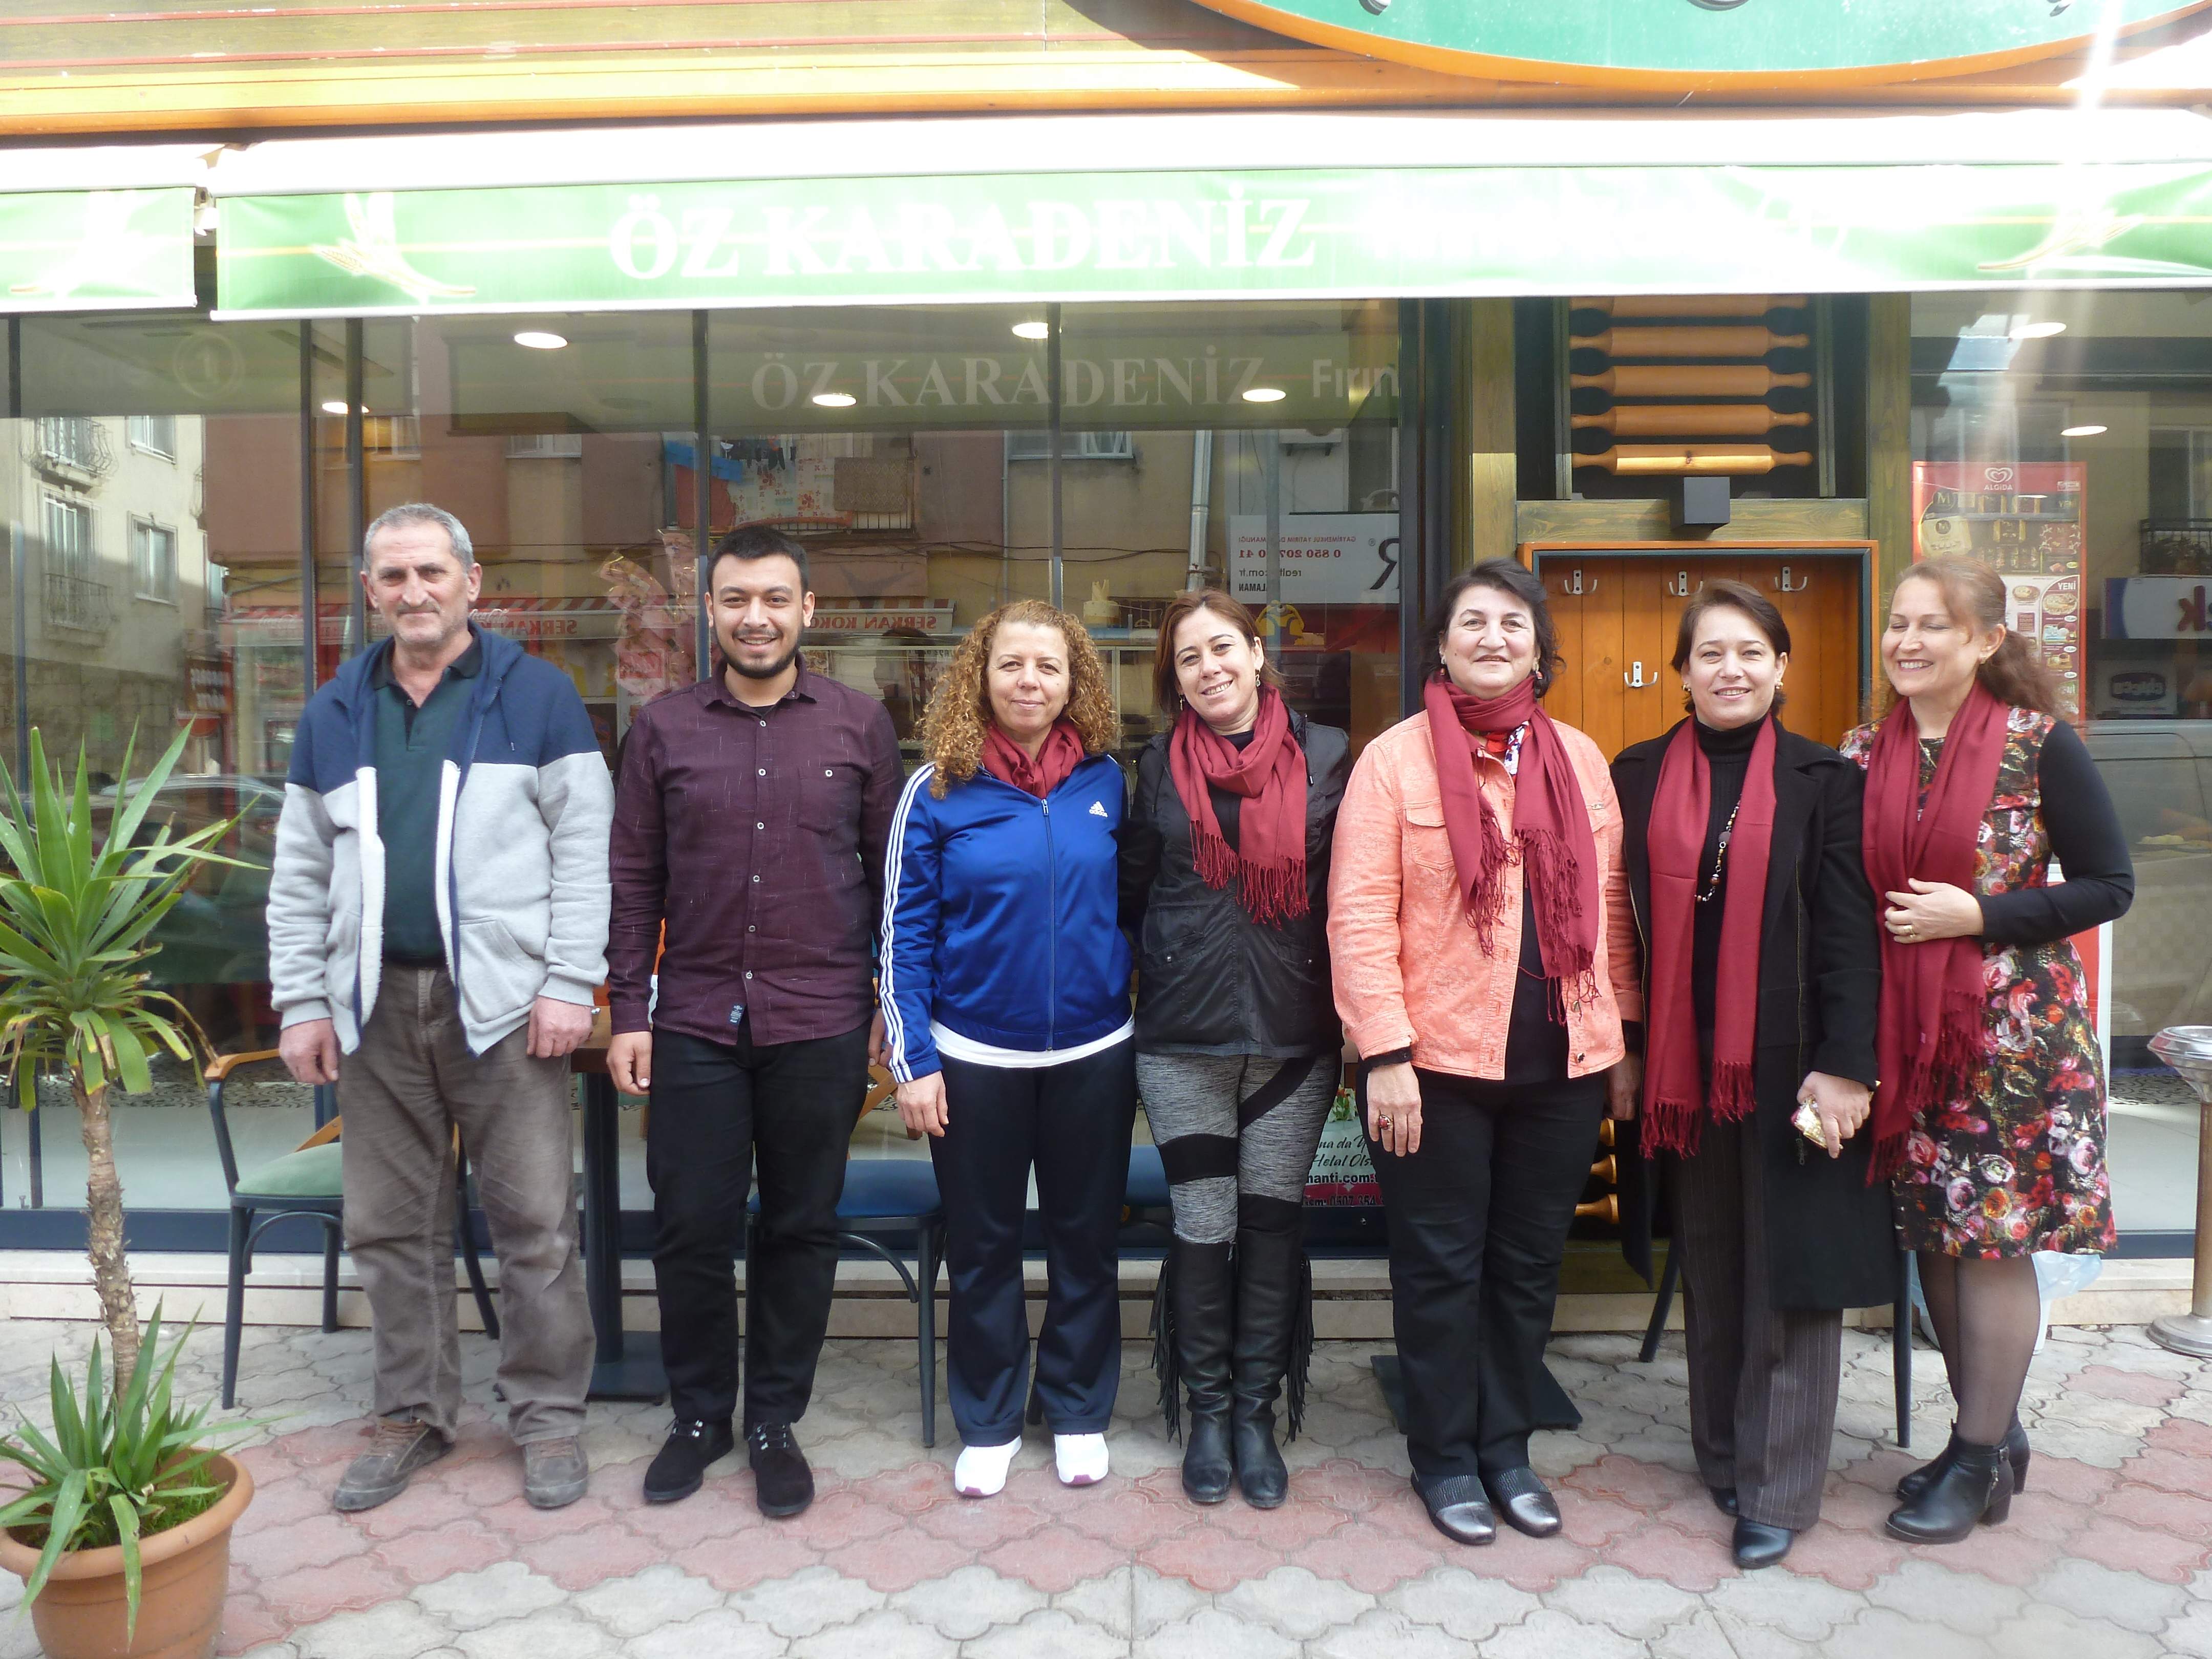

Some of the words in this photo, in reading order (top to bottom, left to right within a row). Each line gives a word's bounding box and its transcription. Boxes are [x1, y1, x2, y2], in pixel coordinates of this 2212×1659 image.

[610, 195, 740, 280] ÖZ
[762, 182, 1316, 276] KARADENİZ
[752, 352, 839, 411] ÖZ
[863, 344, 1266, 408] KARADENİZ
[2057, 580, 2076, 590] YENİ
[1349, 1154, 1373, 1167] Ols
